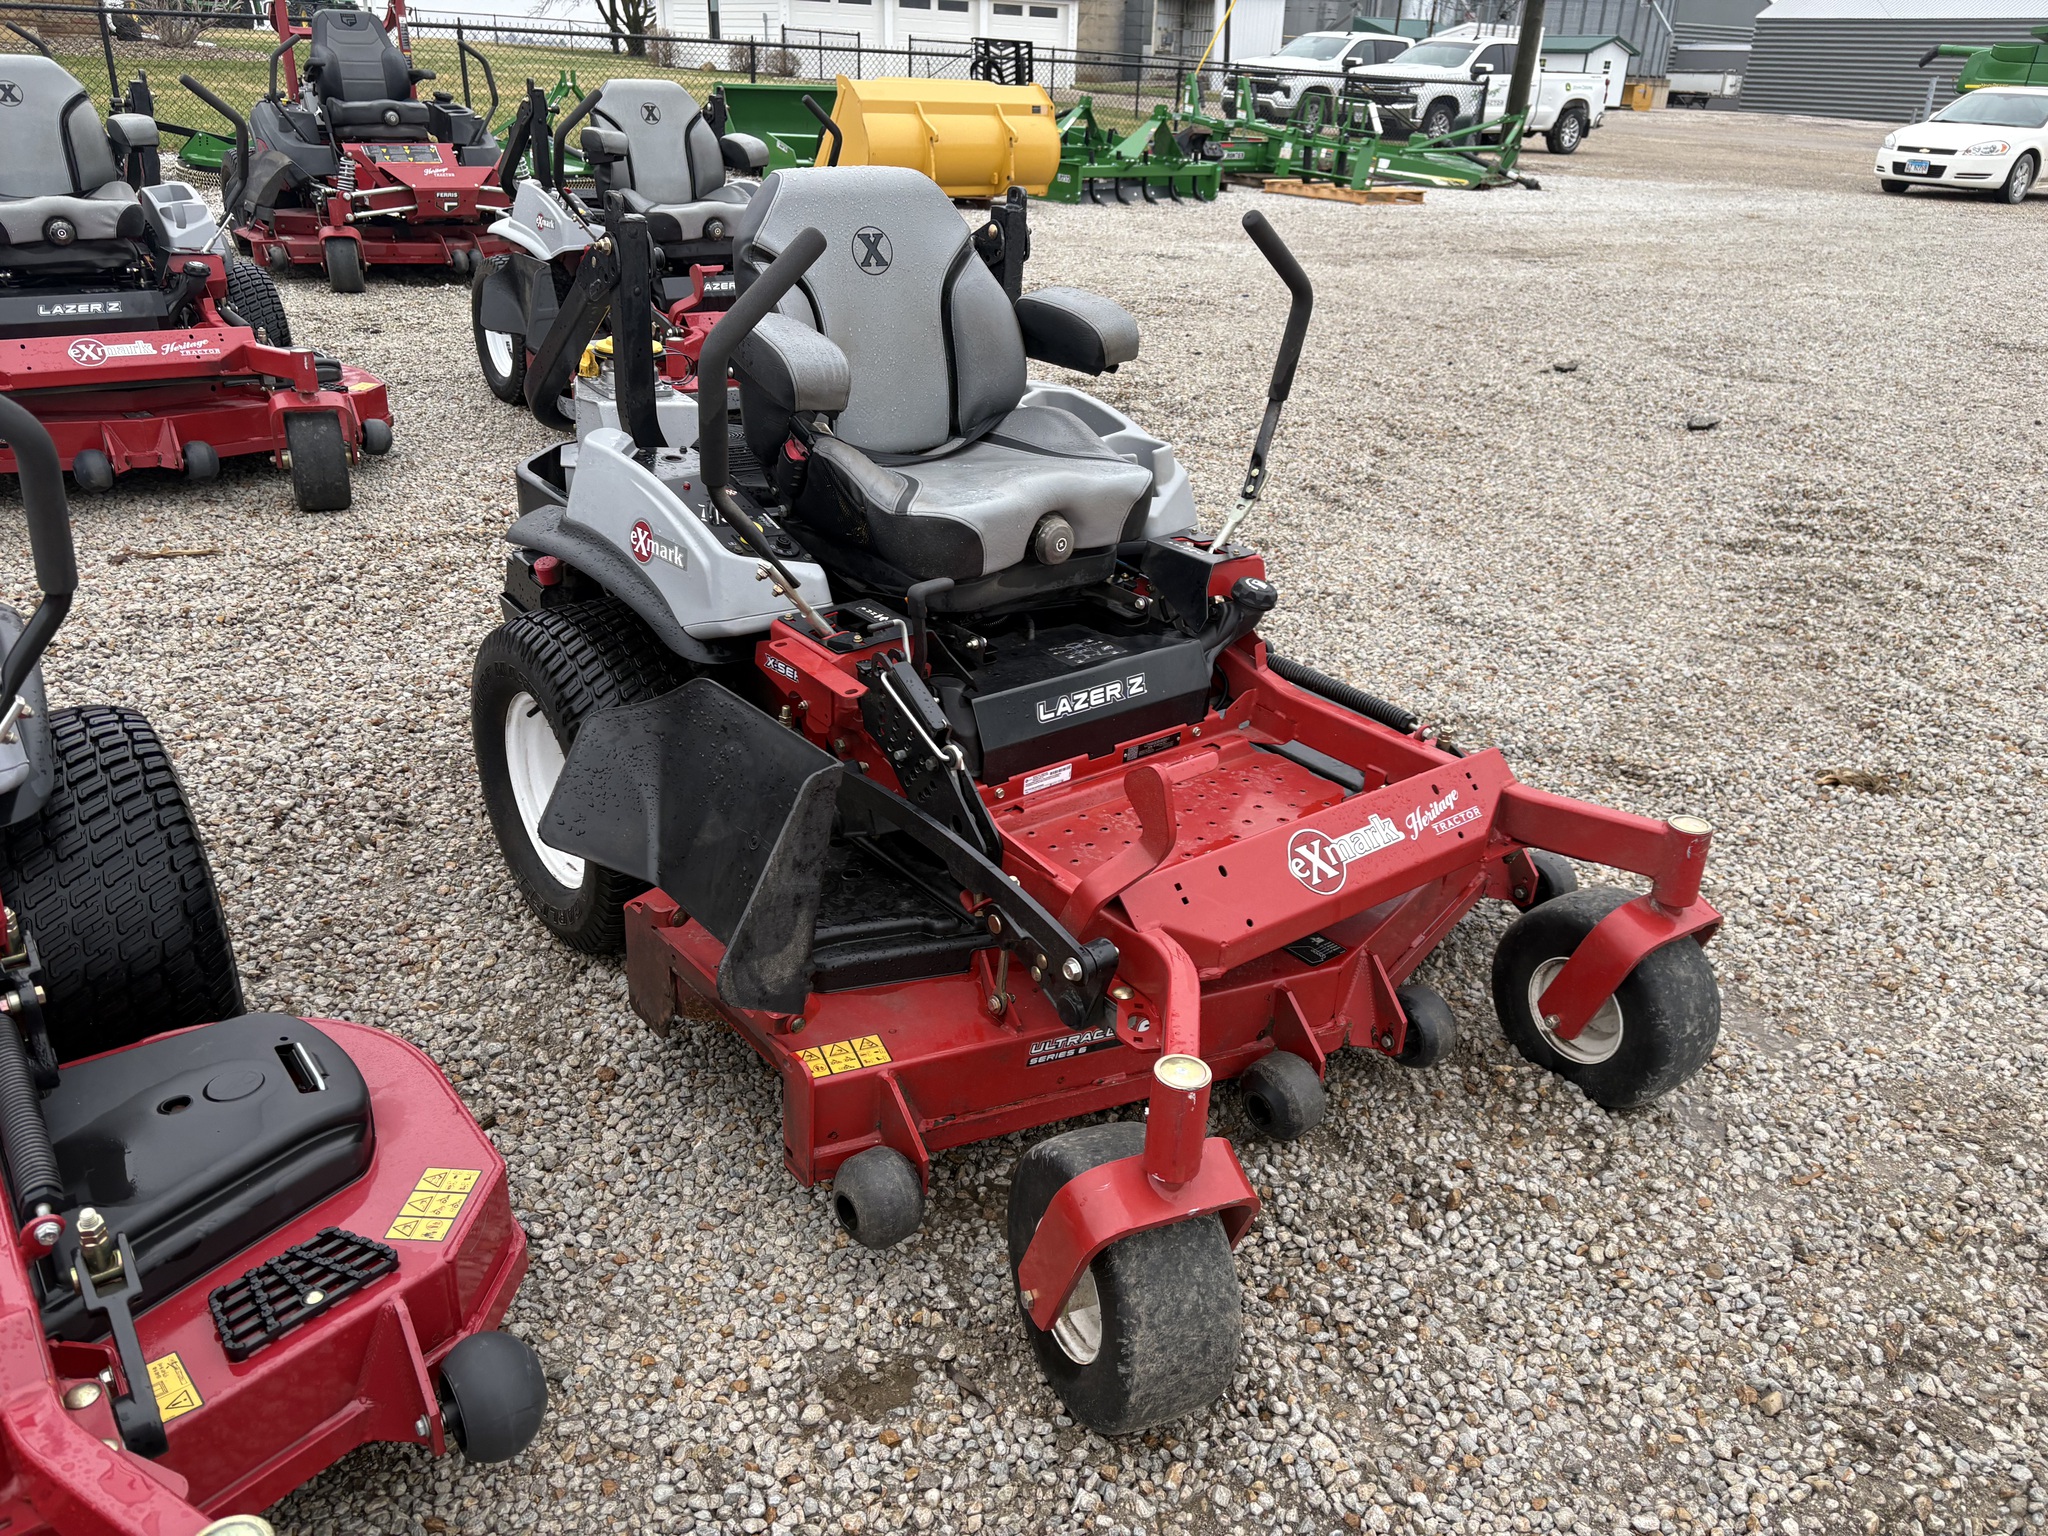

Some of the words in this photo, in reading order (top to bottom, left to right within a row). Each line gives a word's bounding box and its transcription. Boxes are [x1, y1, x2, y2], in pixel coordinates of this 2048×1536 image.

[856, 232, 889, 268] X
[704, 282, 736, 291] AZER
[38, 303, 105, 316] LAZER
[107, 301, 122, 313] Z
[161, 338, 209, 355] Heritage
[180, 347, 221, 357] TRACTOR
[1037, 680, 1125, 723] LAZER
[1126, 672, 1147, 698] Z
[1405, 789, 1459, 840] Heritage
[1431, 806, 1482, 835] TRACTOR
[1029, 1048, 1075, 1065] SERIES
